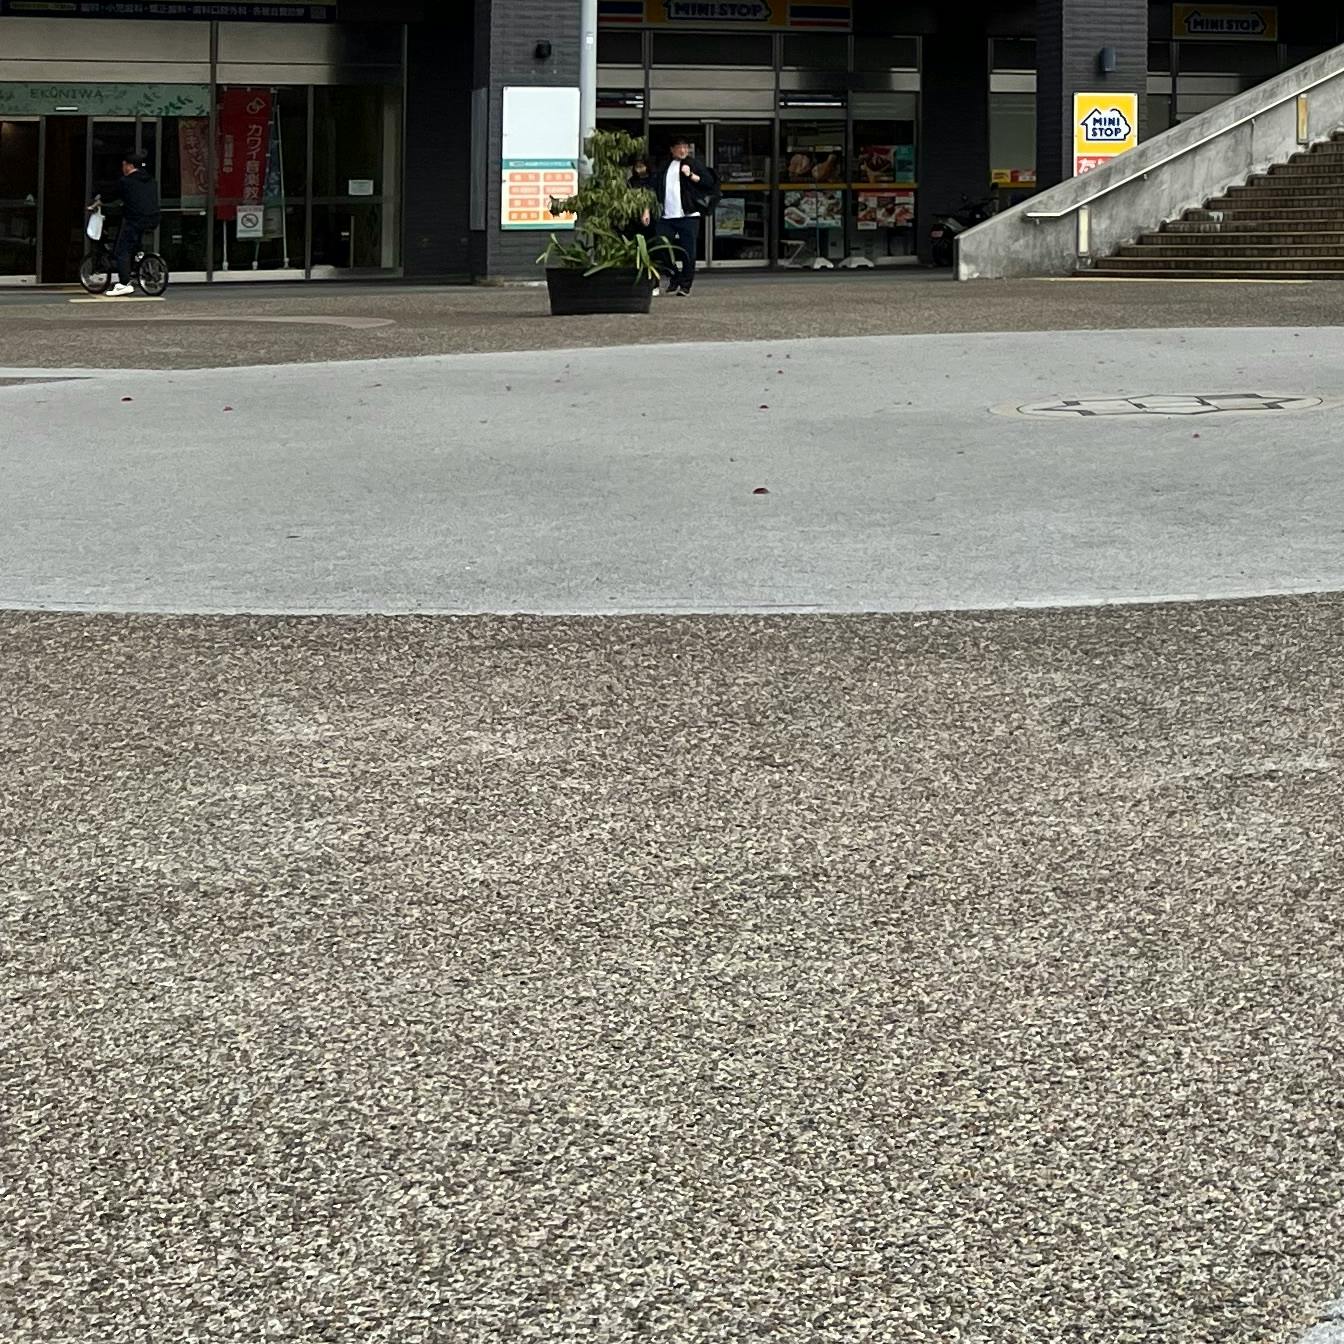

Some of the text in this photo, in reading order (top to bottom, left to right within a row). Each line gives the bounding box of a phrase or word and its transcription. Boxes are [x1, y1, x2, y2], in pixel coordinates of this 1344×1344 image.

[1092, 117, 1121, 126] MINI
[1091, 128, 1122, 137] STOP
[243, 124, 263, 203] カワイ音楽教
